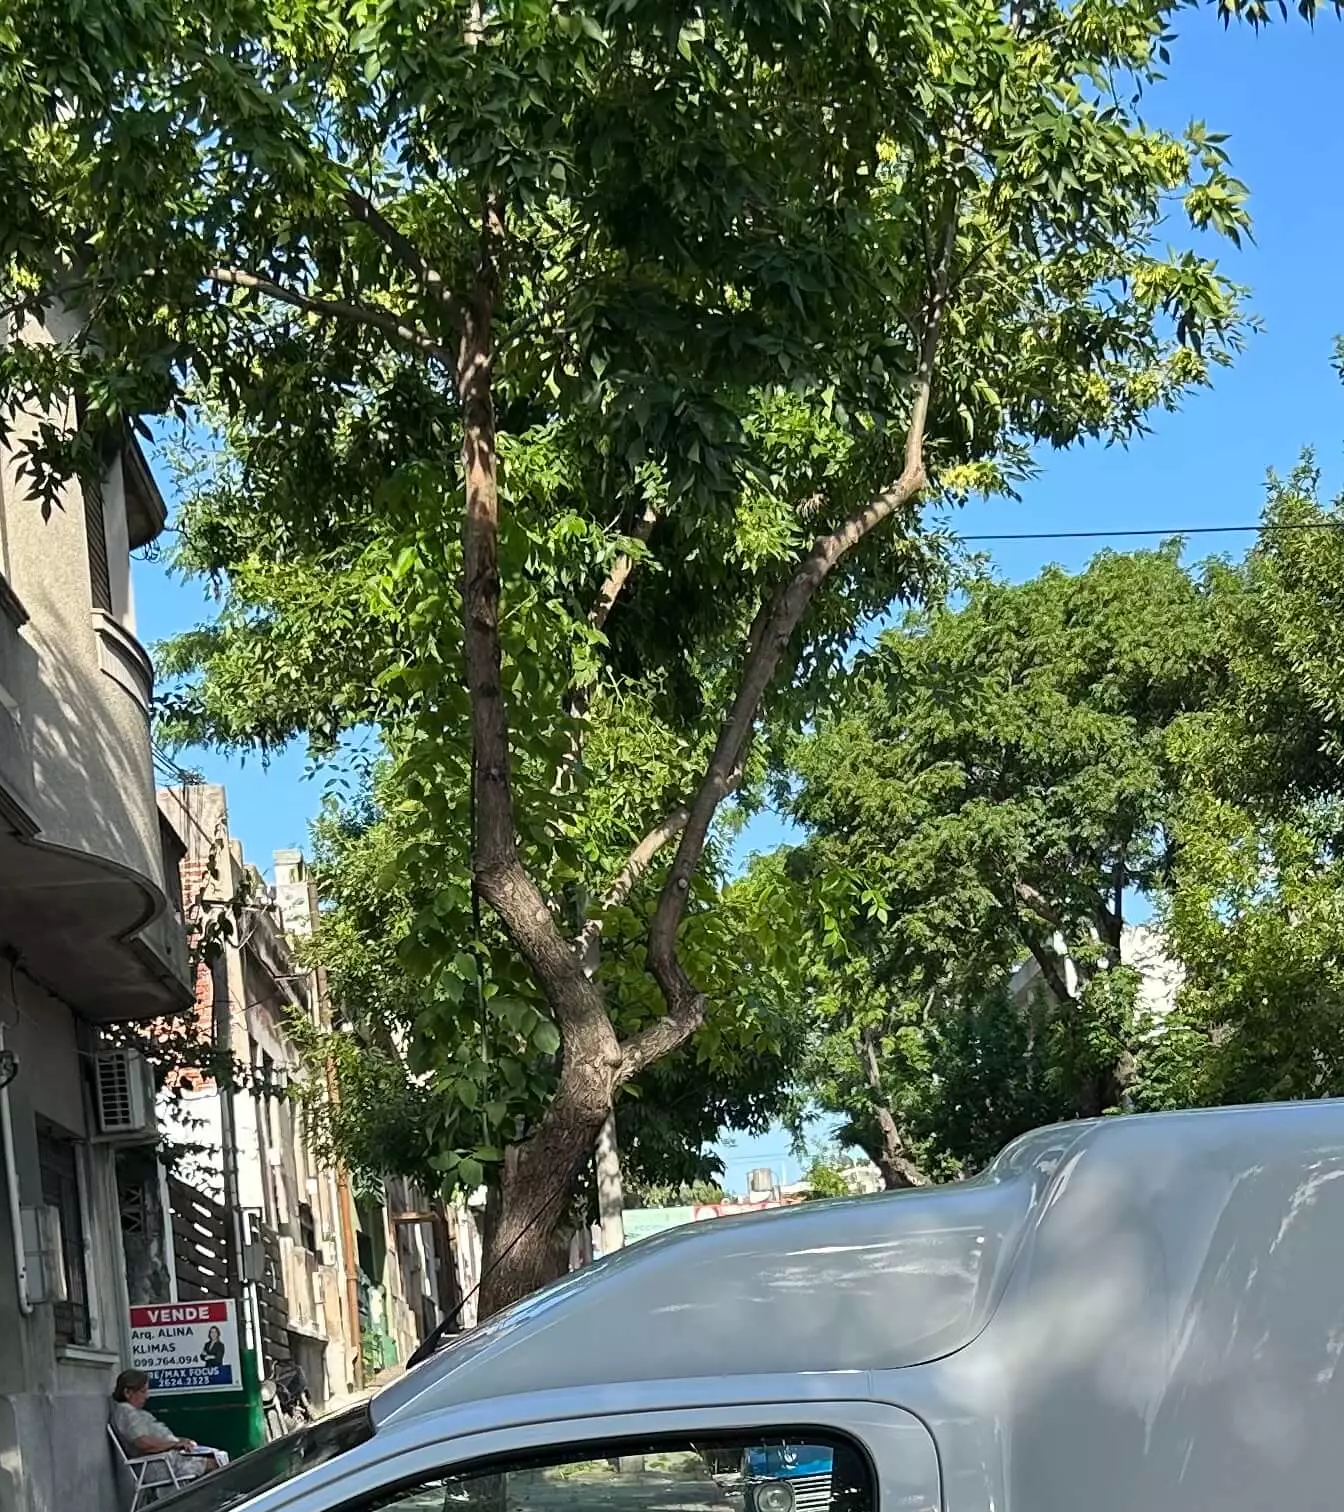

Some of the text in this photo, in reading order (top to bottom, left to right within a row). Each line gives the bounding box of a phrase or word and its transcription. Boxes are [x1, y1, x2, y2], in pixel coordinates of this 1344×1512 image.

[147, 1306, 210, 1323] VENDE
[131, 1326, 194, 1341] Arq. ALINA
[132, 1343, 176, 1355] KLIMAS
[133, 1355, 199, 1368] 099.764.094
[189, 1366, 220, 1377] FOCUS
